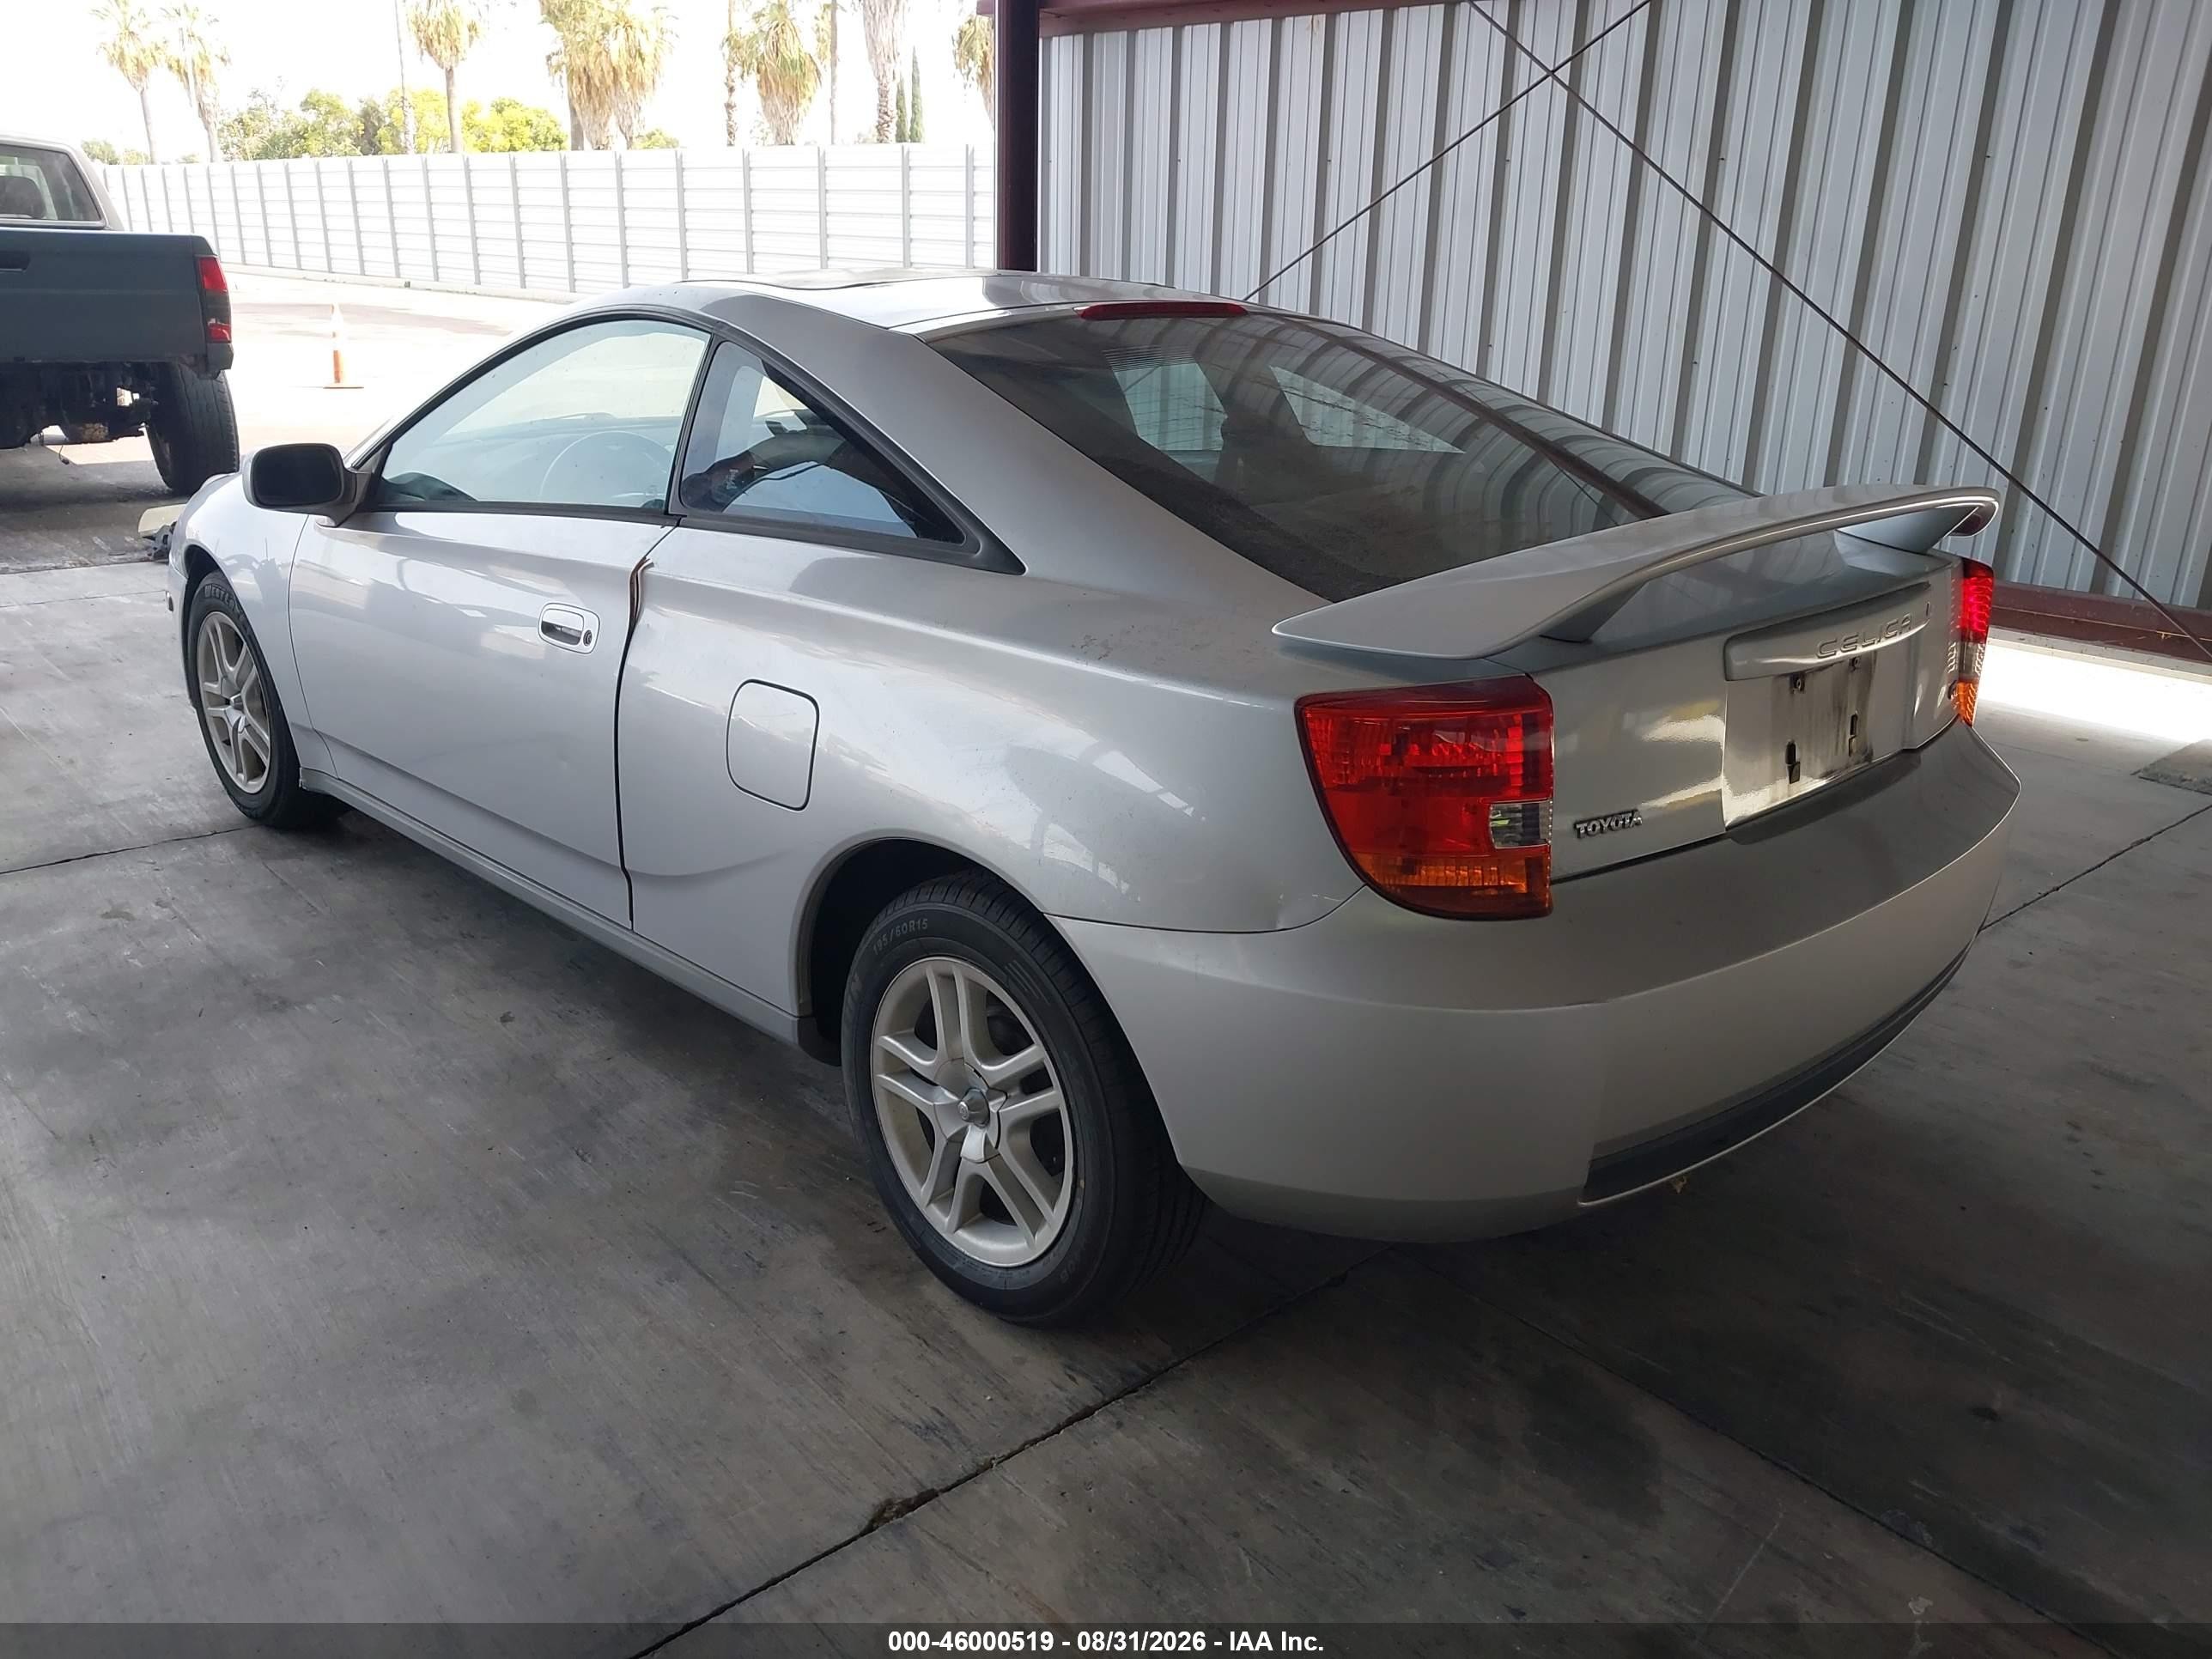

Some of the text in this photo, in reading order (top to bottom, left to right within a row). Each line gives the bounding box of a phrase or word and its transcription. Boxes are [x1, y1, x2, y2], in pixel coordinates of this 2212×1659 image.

[1816, 612, 1912, 659] CELICA
[1574, 809, 1643, 839] TOYOTA
[872, 917, 928, 956] 195/60R15
